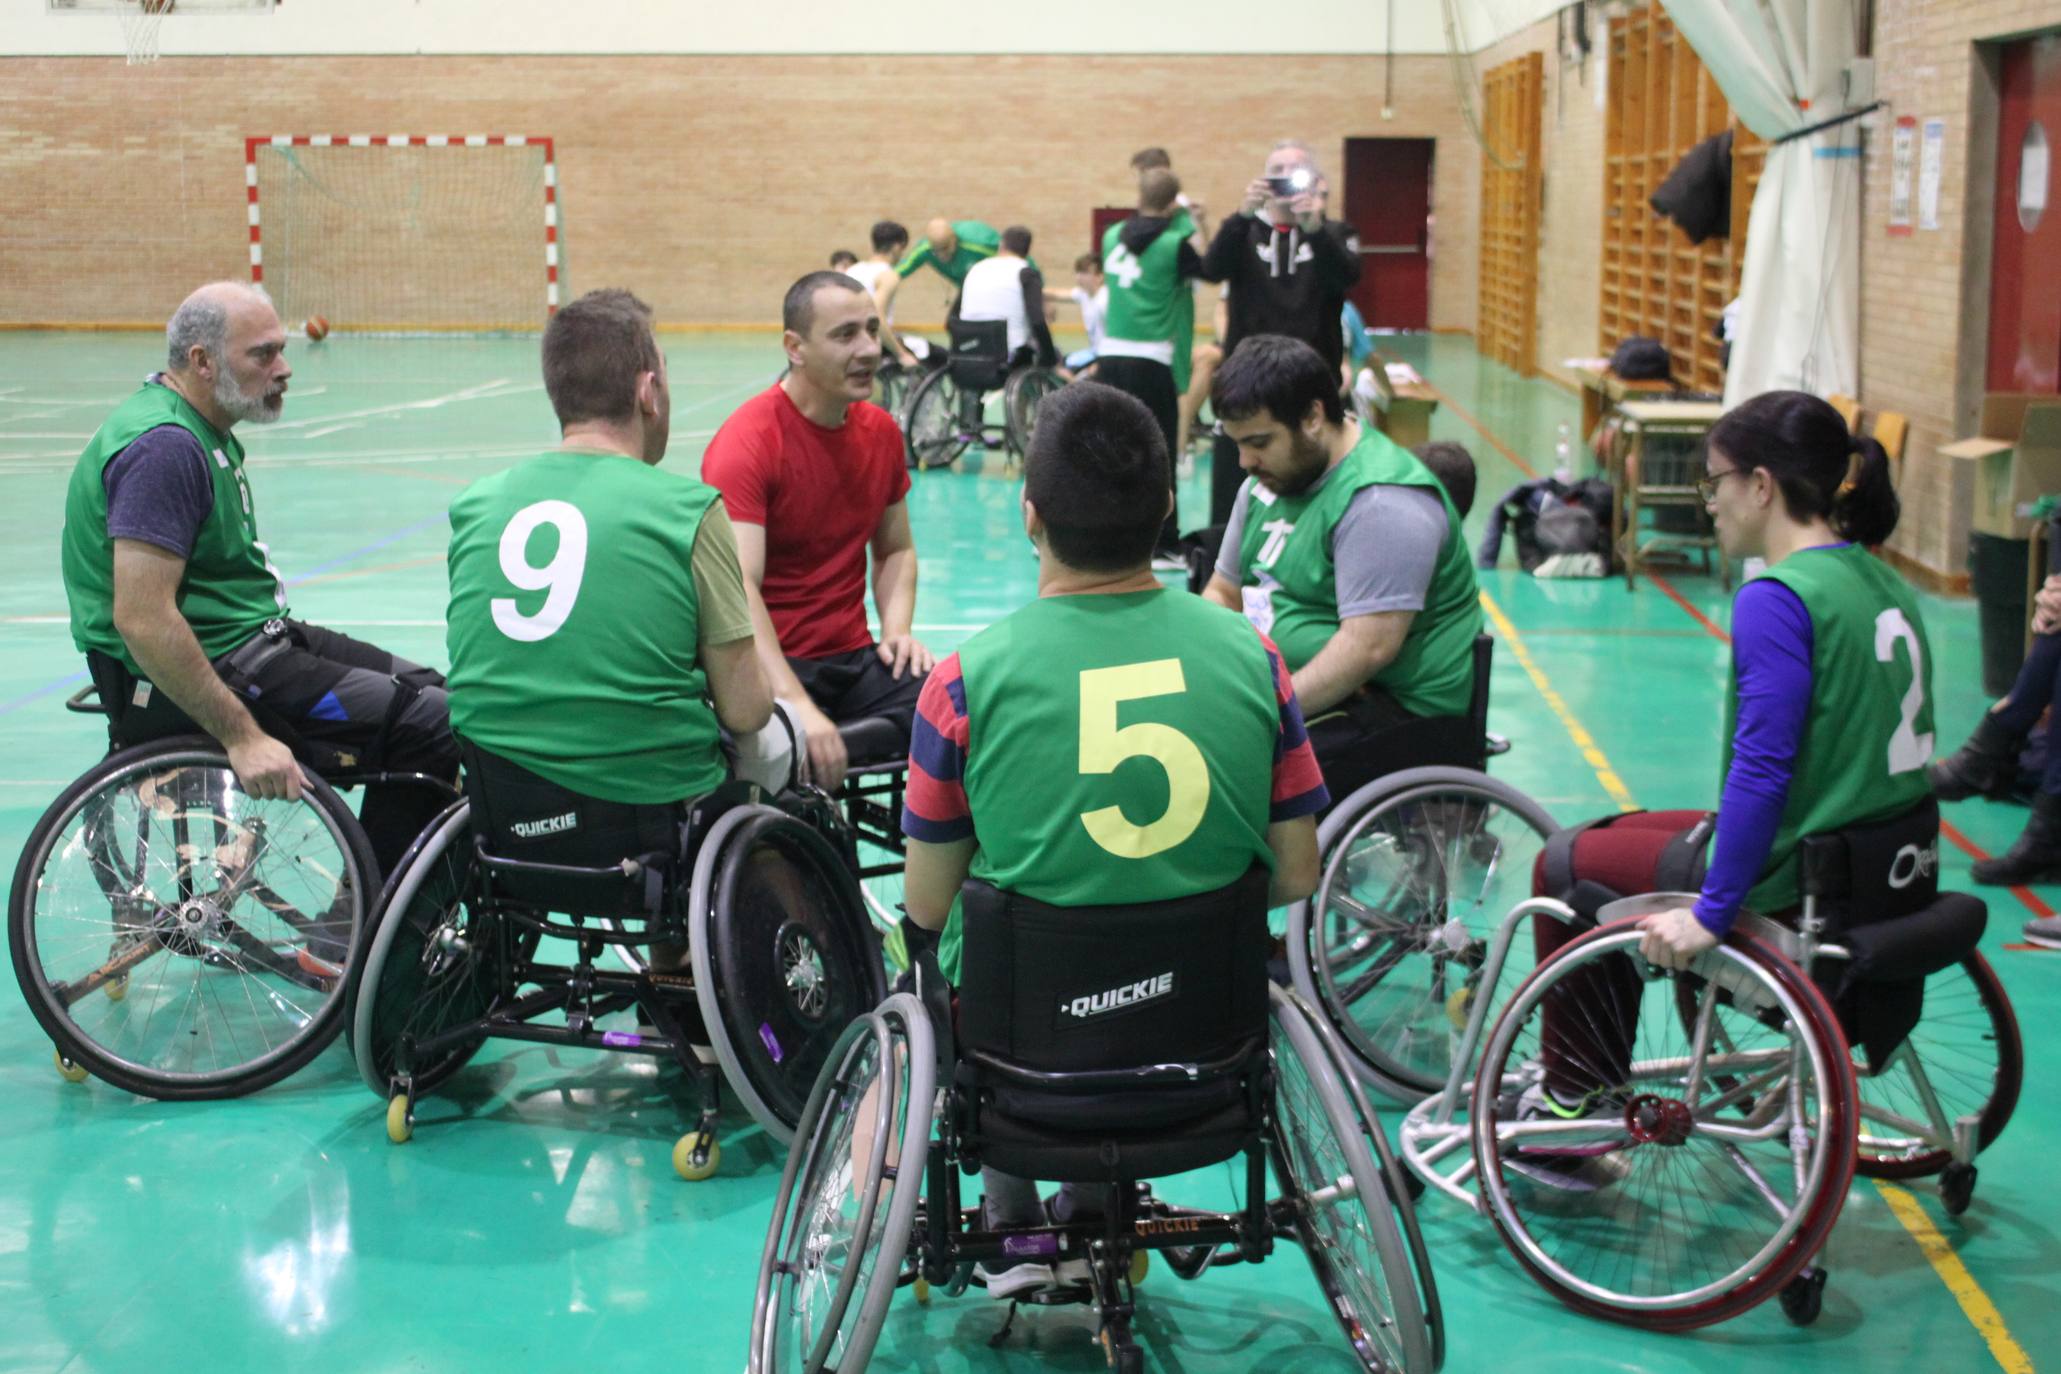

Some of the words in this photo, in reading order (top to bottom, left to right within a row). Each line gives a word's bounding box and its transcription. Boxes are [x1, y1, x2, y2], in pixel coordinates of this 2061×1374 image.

[1103, 243, 1141, 288] 4
[491, 499, 588, 641] 9
[1875, 608, 1933, 775] 2
[1078, 657, 1210, 859] 5
[514, 811, 577, 838] QUICKIE
[1070, 972, 1173, 1018] QUICKIE
